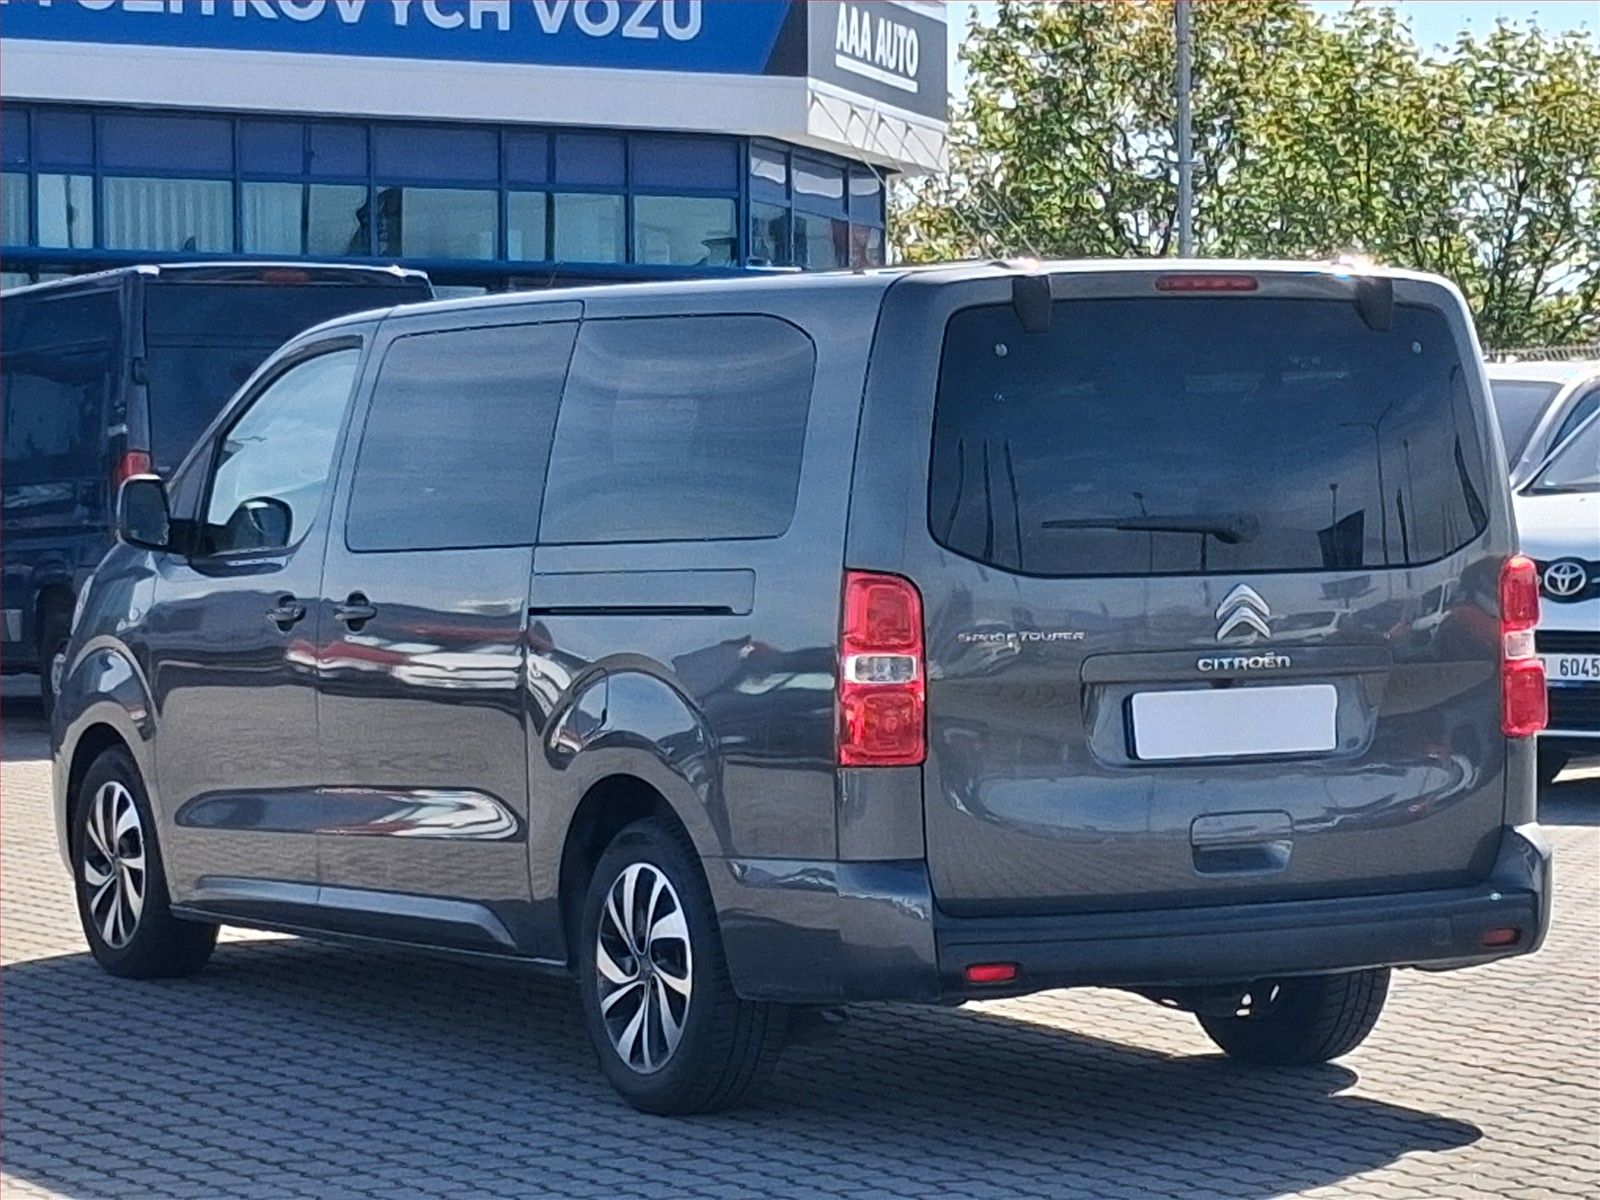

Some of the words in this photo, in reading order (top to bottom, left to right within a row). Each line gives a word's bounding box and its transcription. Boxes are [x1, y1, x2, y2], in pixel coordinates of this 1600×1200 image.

[836, 2, 871, 62] AAA
[875, 17, 919, 77] AUTO
[1560, 657, 1600, 677] 6045
